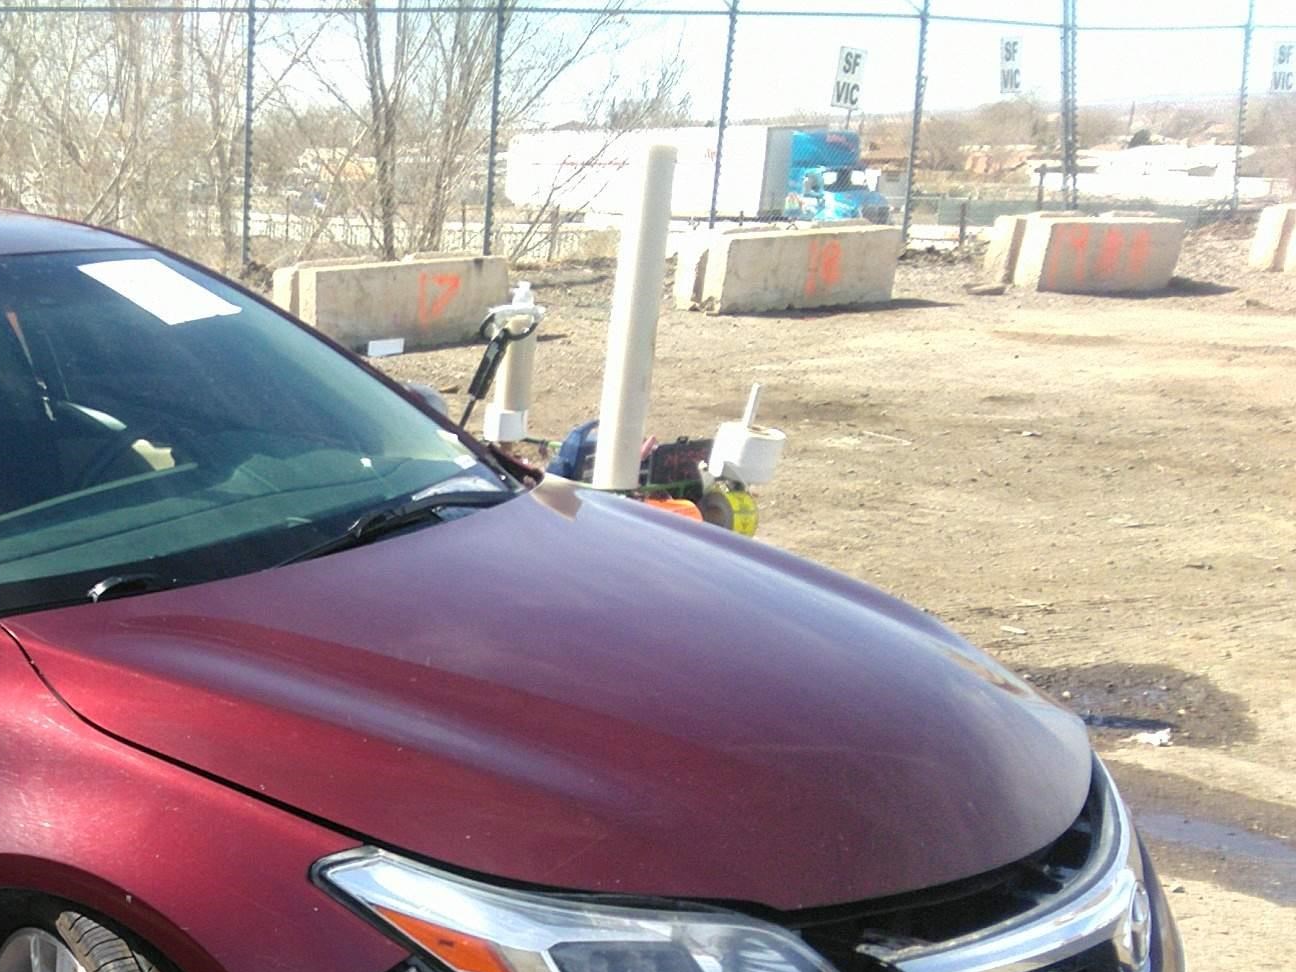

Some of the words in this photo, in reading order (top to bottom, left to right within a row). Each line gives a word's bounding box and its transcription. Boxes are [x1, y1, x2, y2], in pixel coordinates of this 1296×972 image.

[1004, 40, 1019, 62] SF
[1278, 44, 1295, 65] SF
[843, 51, 862, 75] SF
[1001, 68, 1021, 89] VIC
[1273, 71, 1294, 91] VIC
[836, 81, 860, 106] VIC
